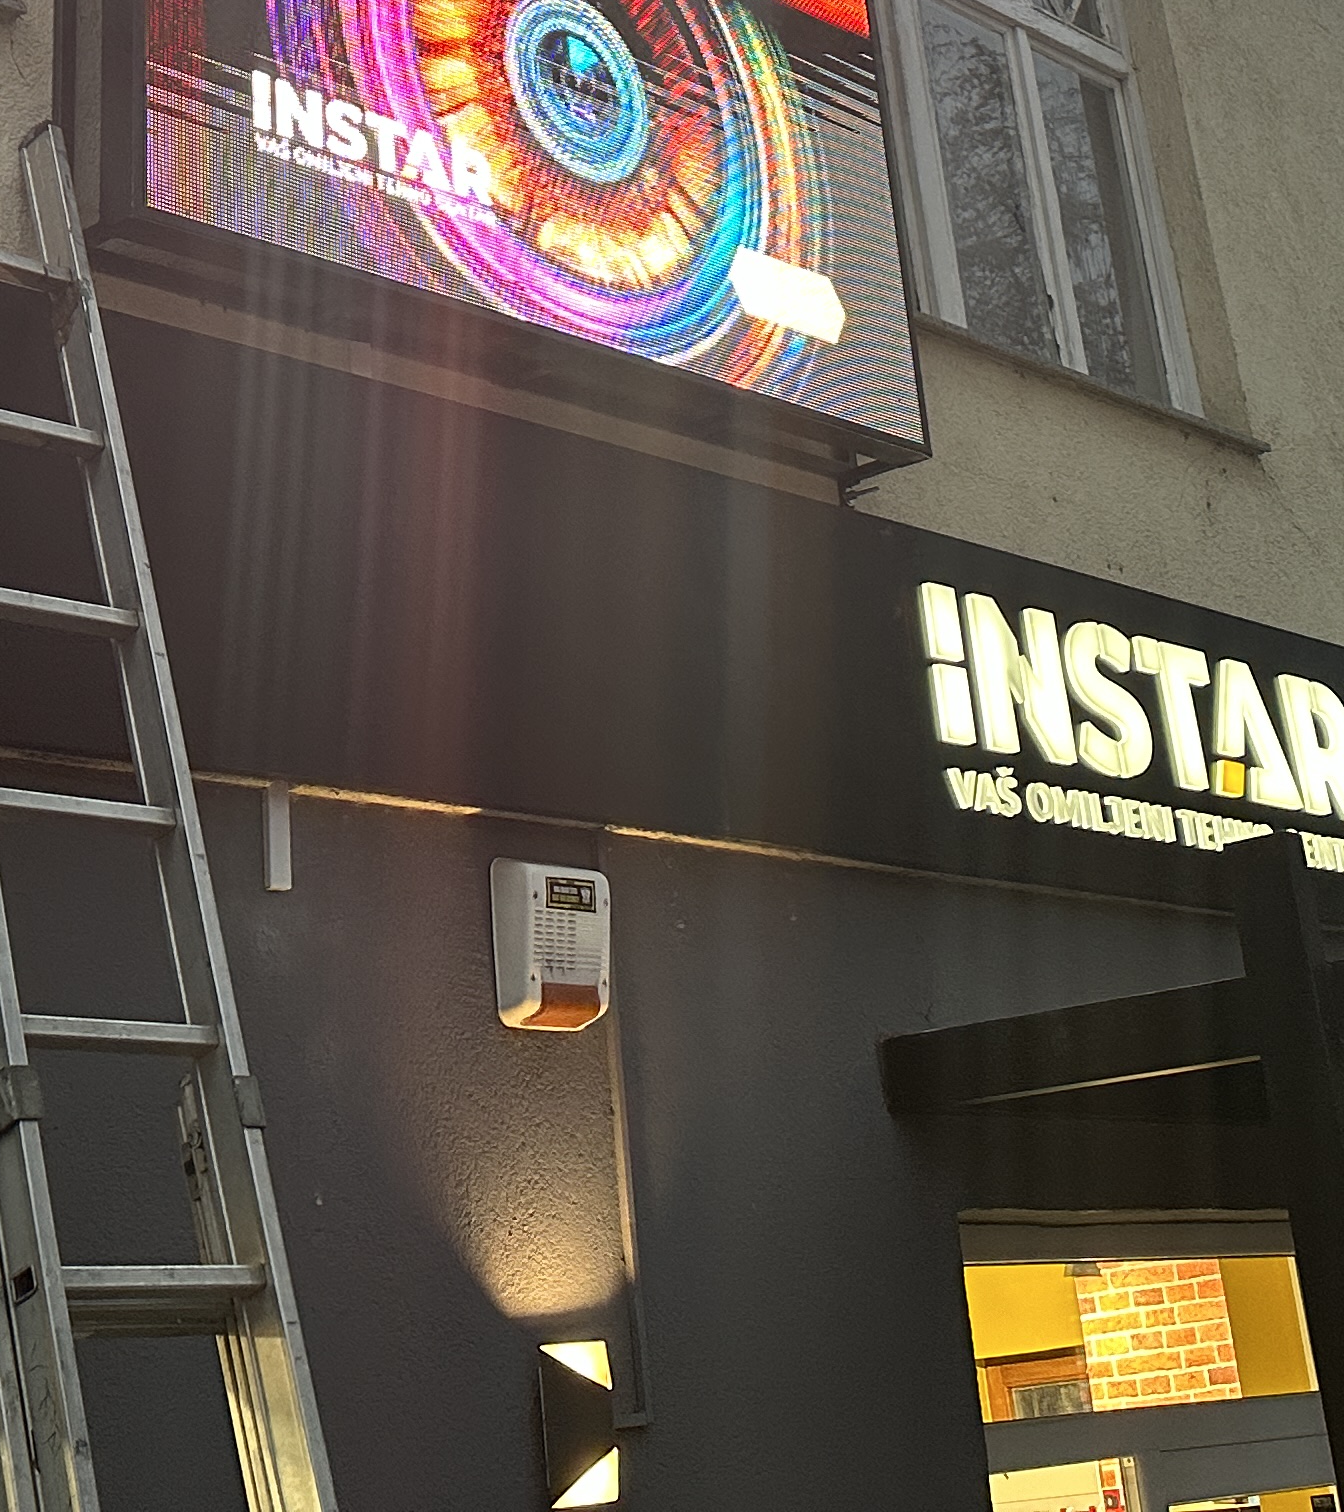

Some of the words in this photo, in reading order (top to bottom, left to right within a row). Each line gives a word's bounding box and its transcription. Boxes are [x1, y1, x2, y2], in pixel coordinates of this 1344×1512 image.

[251, 69, 494, 206] INSTAR
[944, 766, 1023, 818] VAŠ
[1025, 781, 1178, 844] OMILJENI
[1175, 808, 1274, 854] TEH
